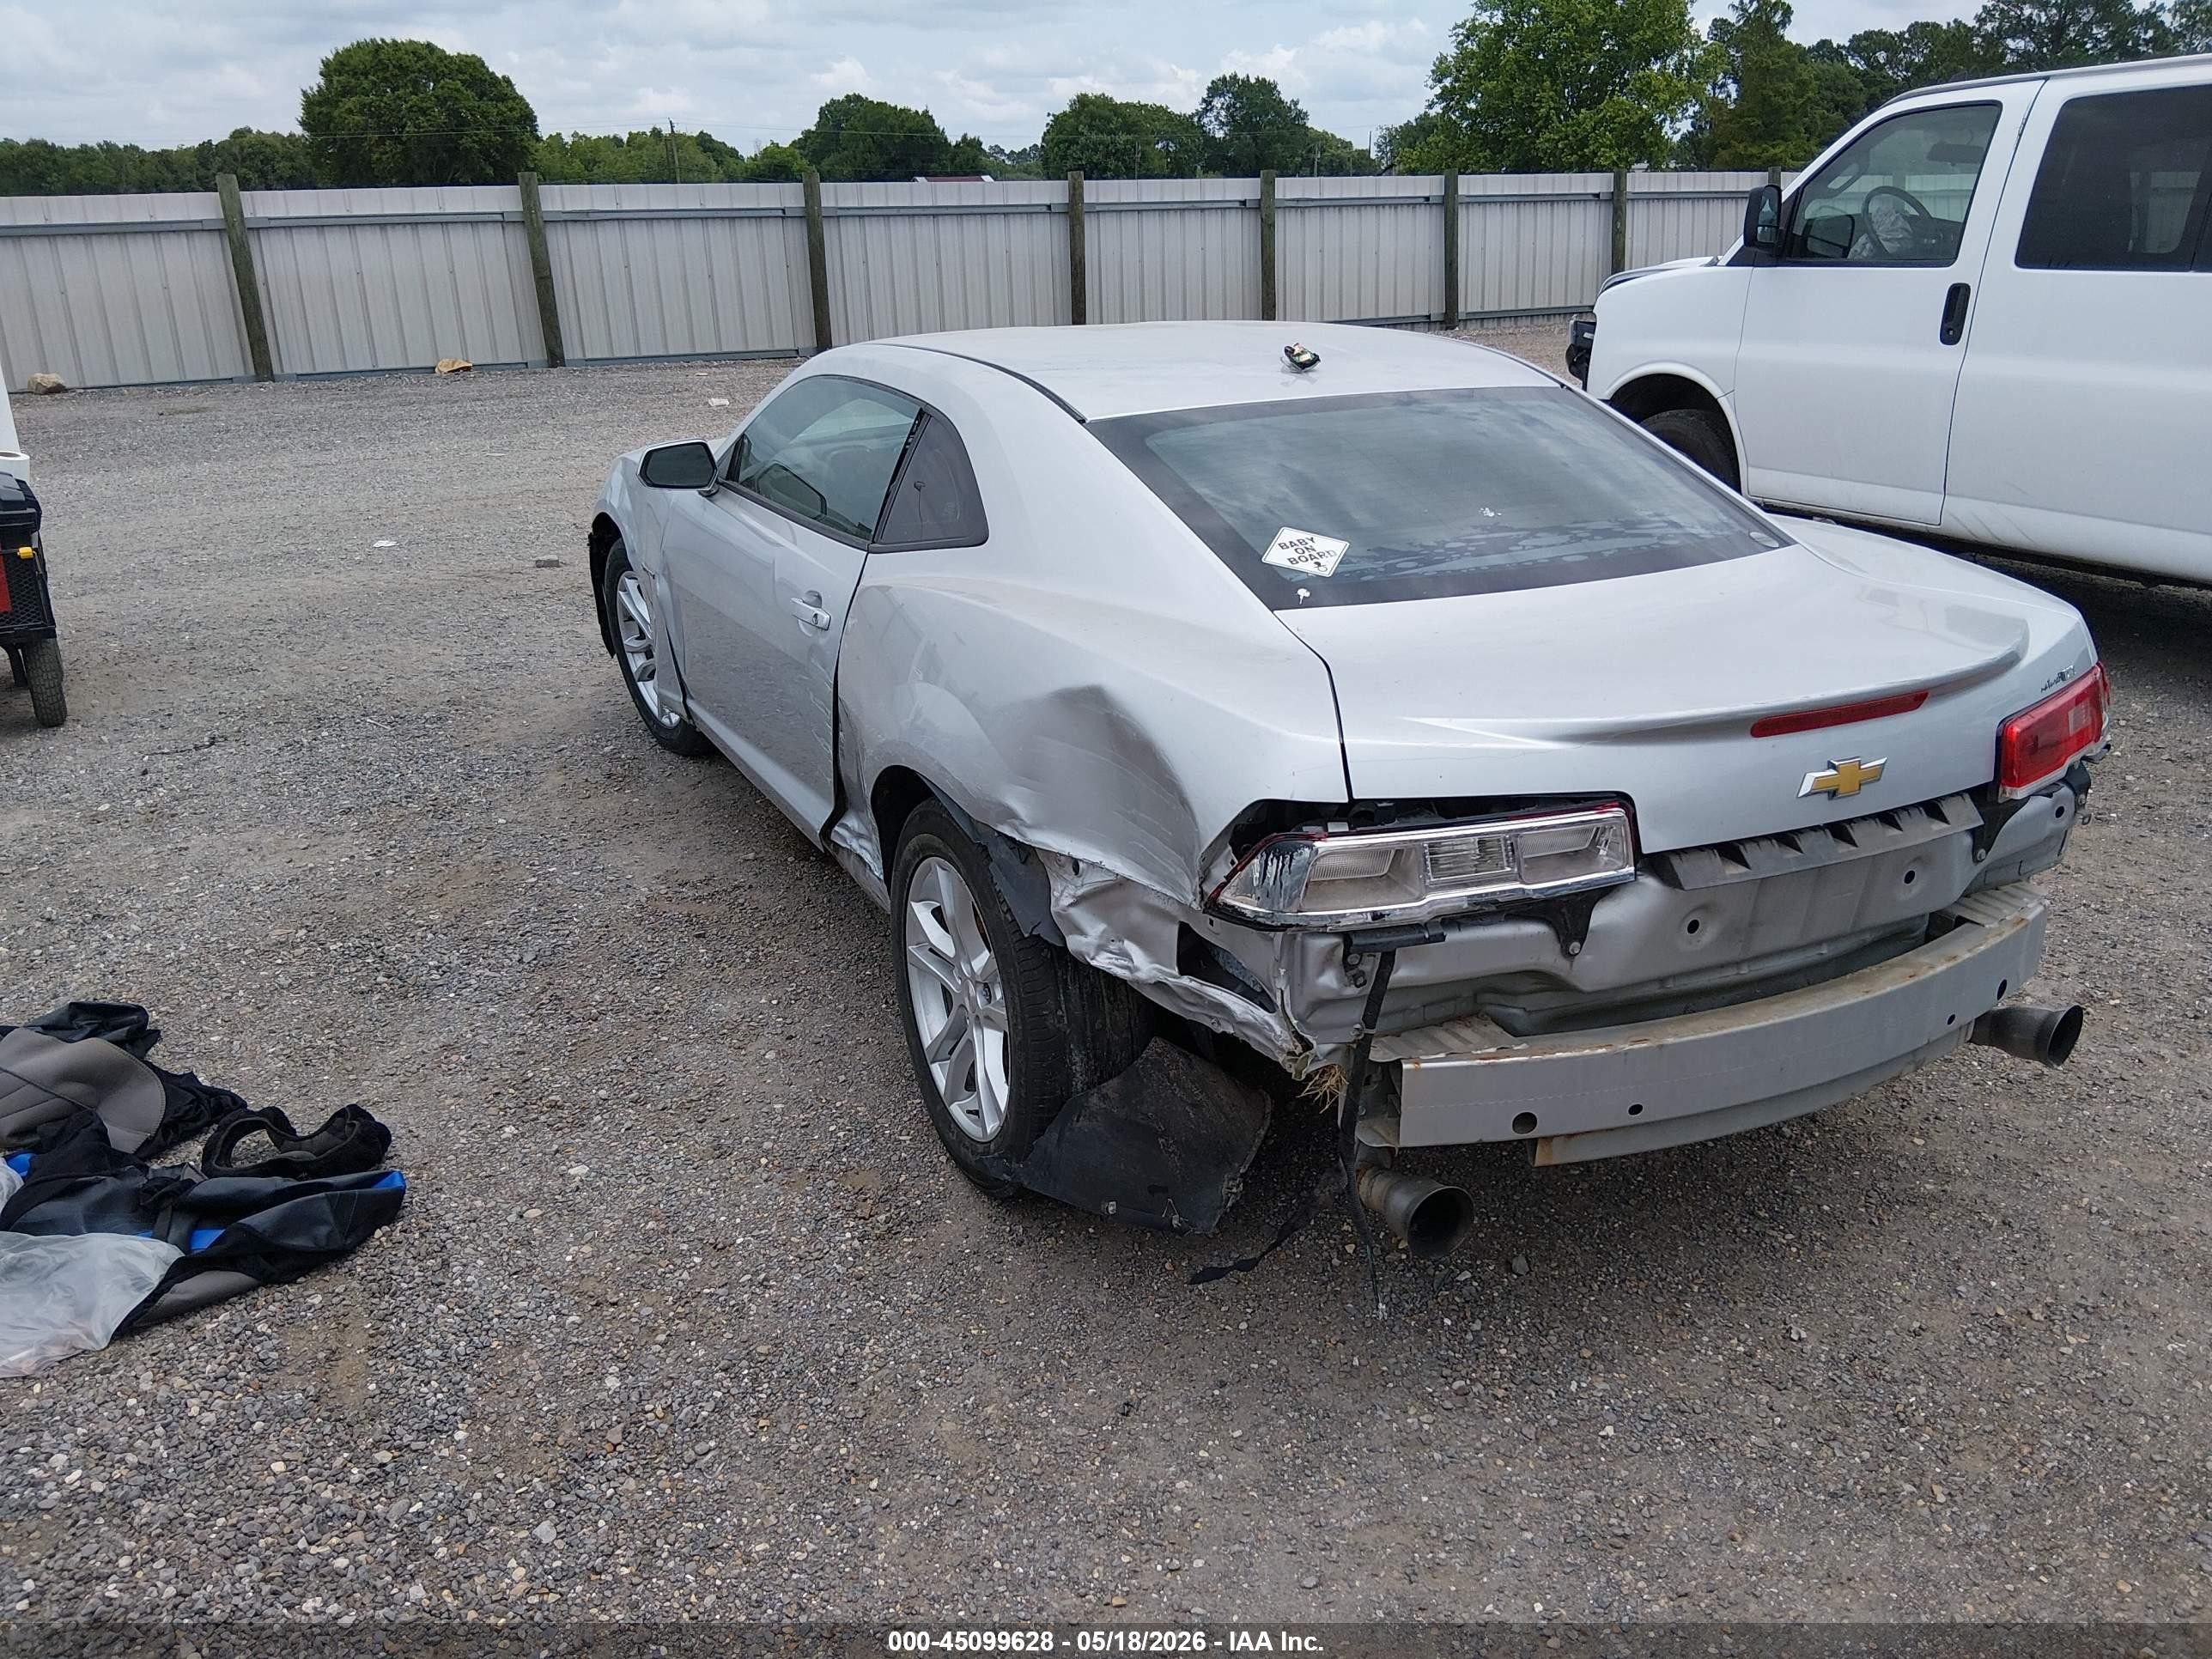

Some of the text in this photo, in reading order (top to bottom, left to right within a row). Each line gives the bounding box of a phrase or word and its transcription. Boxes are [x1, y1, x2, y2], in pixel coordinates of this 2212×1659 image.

[1278, 537, 1316, 550] BABY
[1294, 544, 1316, 556] ON
[1286, 550, 1338, 565] BOARD
